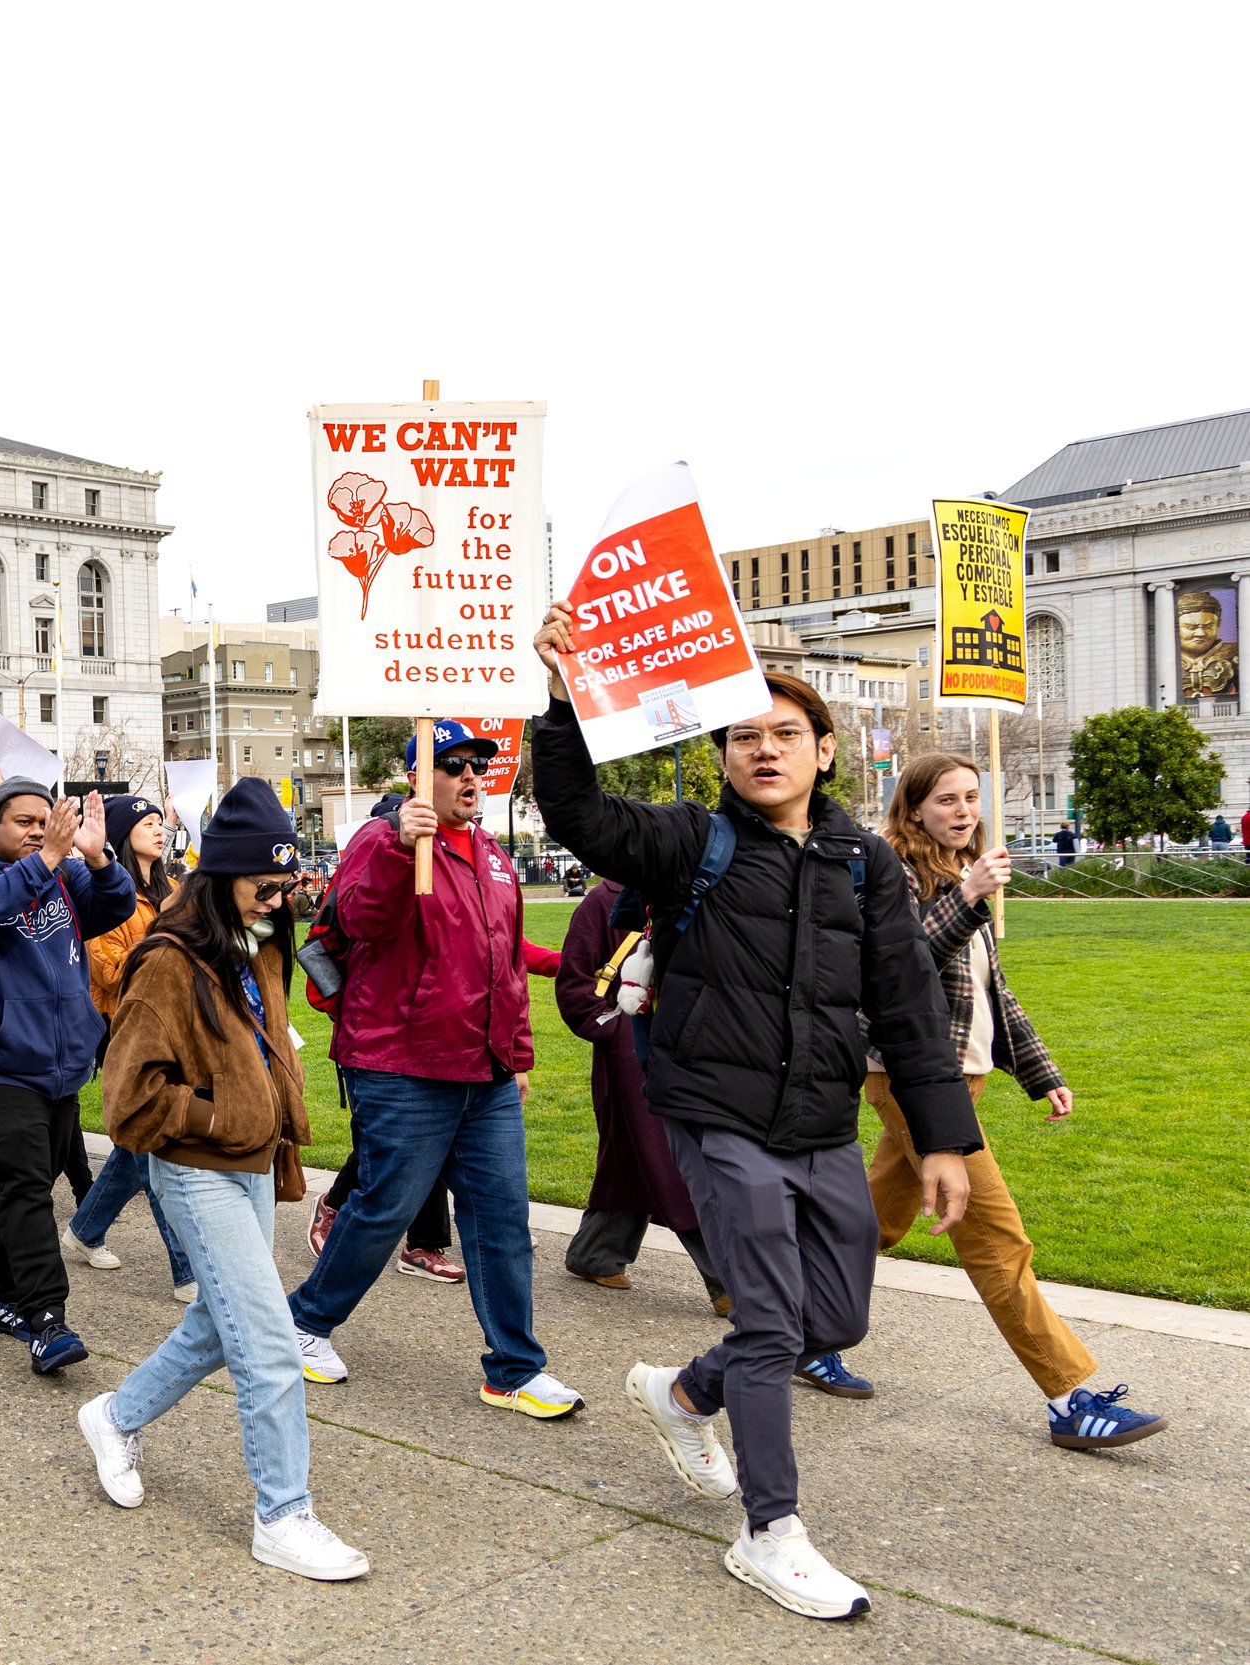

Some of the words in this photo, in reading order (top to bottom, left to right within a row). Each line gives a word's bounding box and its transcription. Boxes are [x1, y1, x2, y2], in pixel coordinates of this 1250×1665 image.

[323, 424, 386, 452] WE
[396, 422, 517, 451] CAN'T
[411, 458, 515, 487] WAIT
[468, 506, 512, 529] for
[957, 509, 1010, 530] NECESITAMOS
[461, 537, 512, 560] the
[942, 524, 1000, 546] ESCUELAS
[1003, 534, 1020, 553] CON
[591, 539, 646, 579] ON
[960, 543, 1011, 569] PERSONAL
[413, 566, 512, 590] future
[956, 563, 1012, 588] COMPLETO
[576, 569, 691, 632] STRIKE
[961, 583, 968, 601] Y
[974, 585, 1013, 608] ESTABLE
[460, 604, 513, 620] our
[375, 627, 515, 650] students
[576, 642, 618, 668] FOR
[621, 624, 668, 654] SAFE
[671, 610, 713, 637] AND
[384, 660, 515, 683] deserve
[574, 660, 640, 692] STABLE
[644, 628, 736, 672] SCHOOLS
[945, 672, 959, 689] NO
[962, 673, 1001, 691] PODEMOS
[480, 718, 504, 732] ON
[488, 756, 519, 765] CHOOLS
